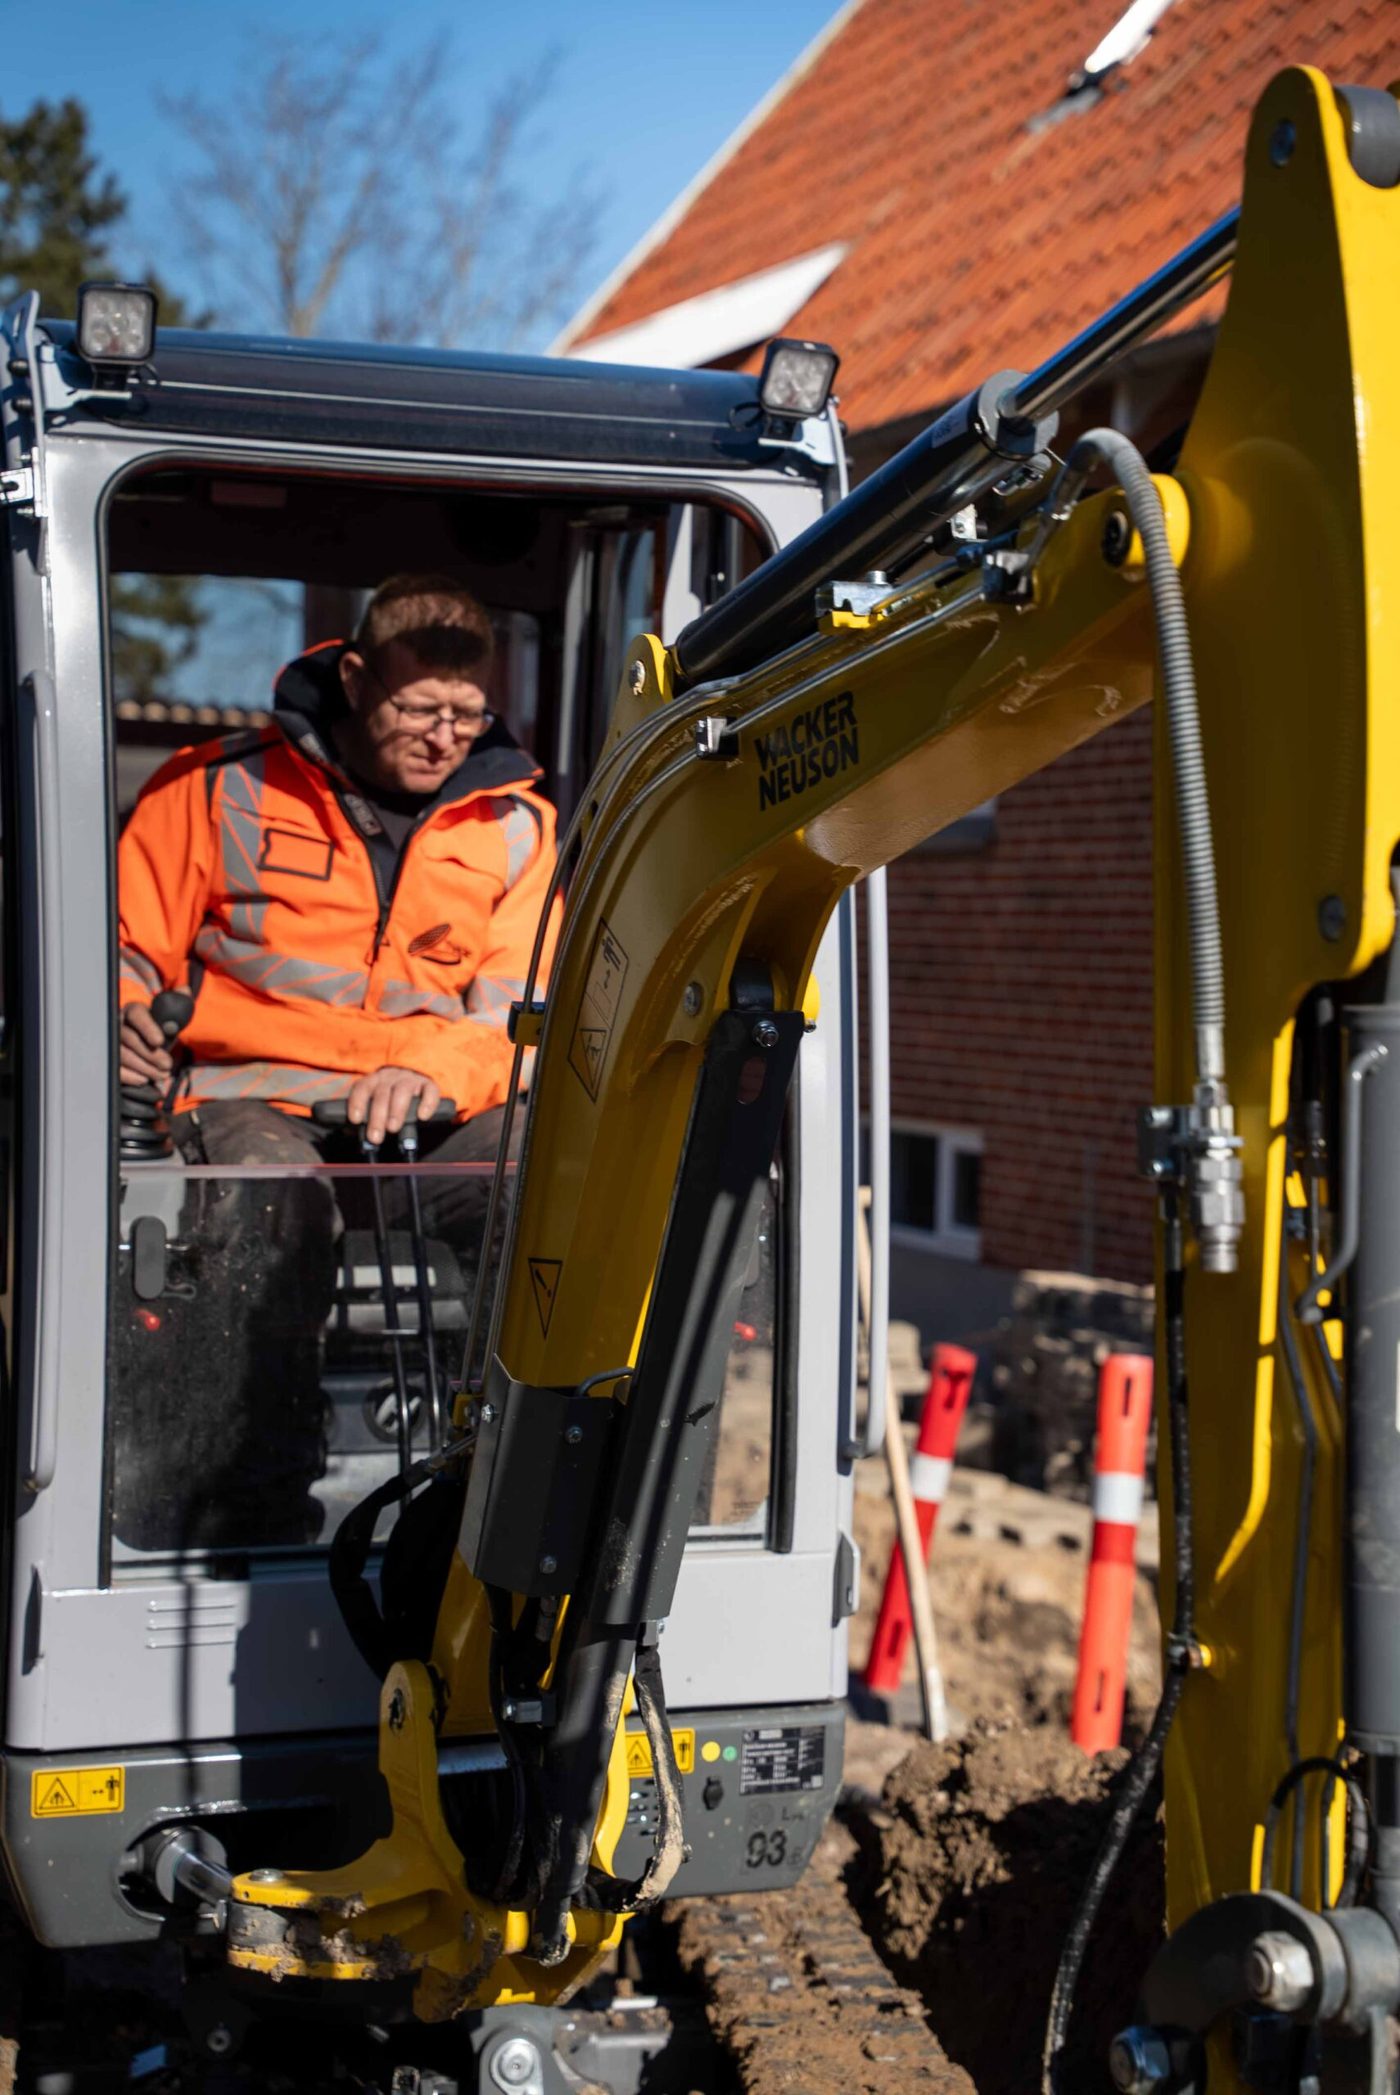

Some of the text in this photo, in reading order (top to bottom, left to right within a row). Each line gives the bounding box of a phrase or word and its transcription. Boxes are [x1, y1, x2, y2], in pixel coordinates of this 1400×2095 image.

[754, 690, 857, 771] WACKER
[758, 726, 859, 811] NEUSON
[746, 1830, 787, 1868] 93
